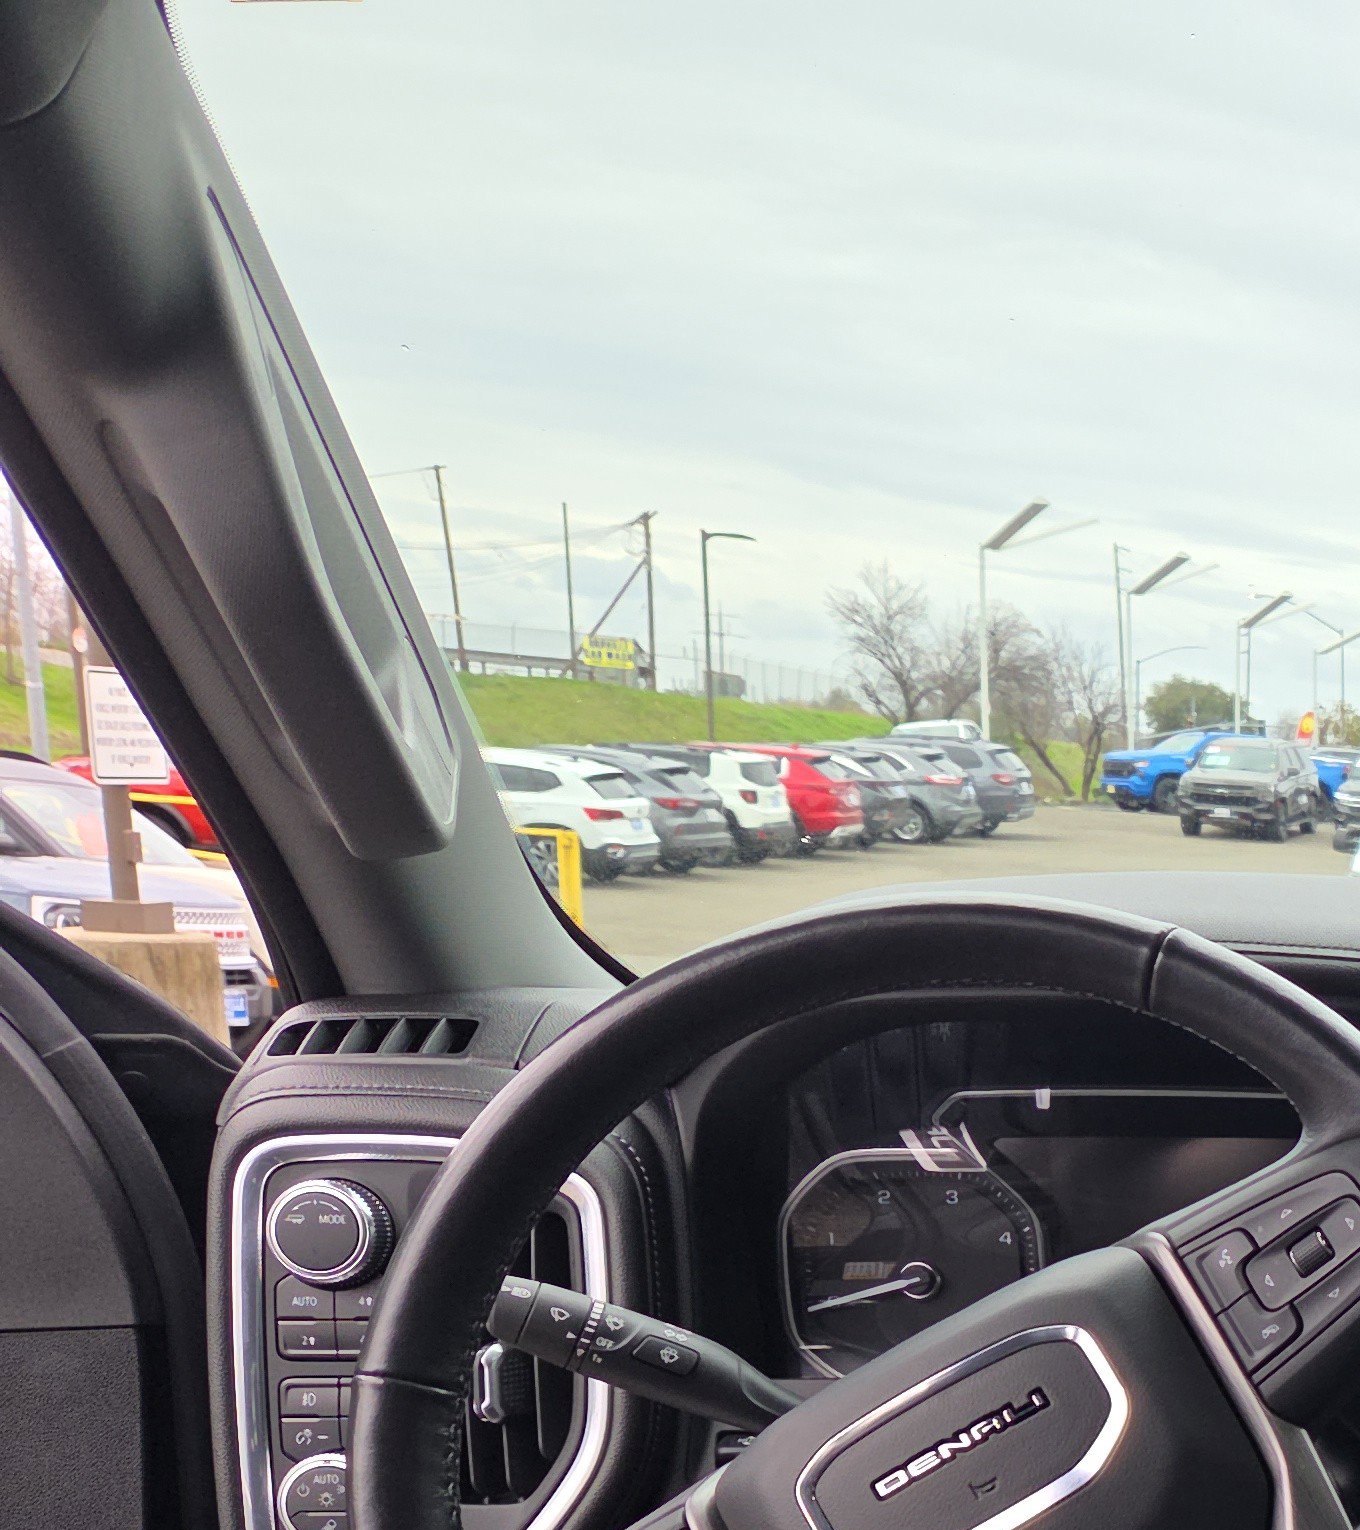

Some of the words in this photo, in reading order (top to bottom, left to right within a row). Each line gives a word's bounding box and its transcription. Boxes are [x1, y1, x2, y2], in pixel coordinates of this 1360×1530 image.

[877, 1189, 891, 1205] 2
[945, 1189, 959, 1205] 3
[318, 1213, 347, 1225] MODE
[998, 1231, 1012, 1245] 4
[291, 1296, 318, 1307] AUTO
[872, 1389, 1048, 1500] DENALI
[313, 1473, 340, 1485] AUTO
